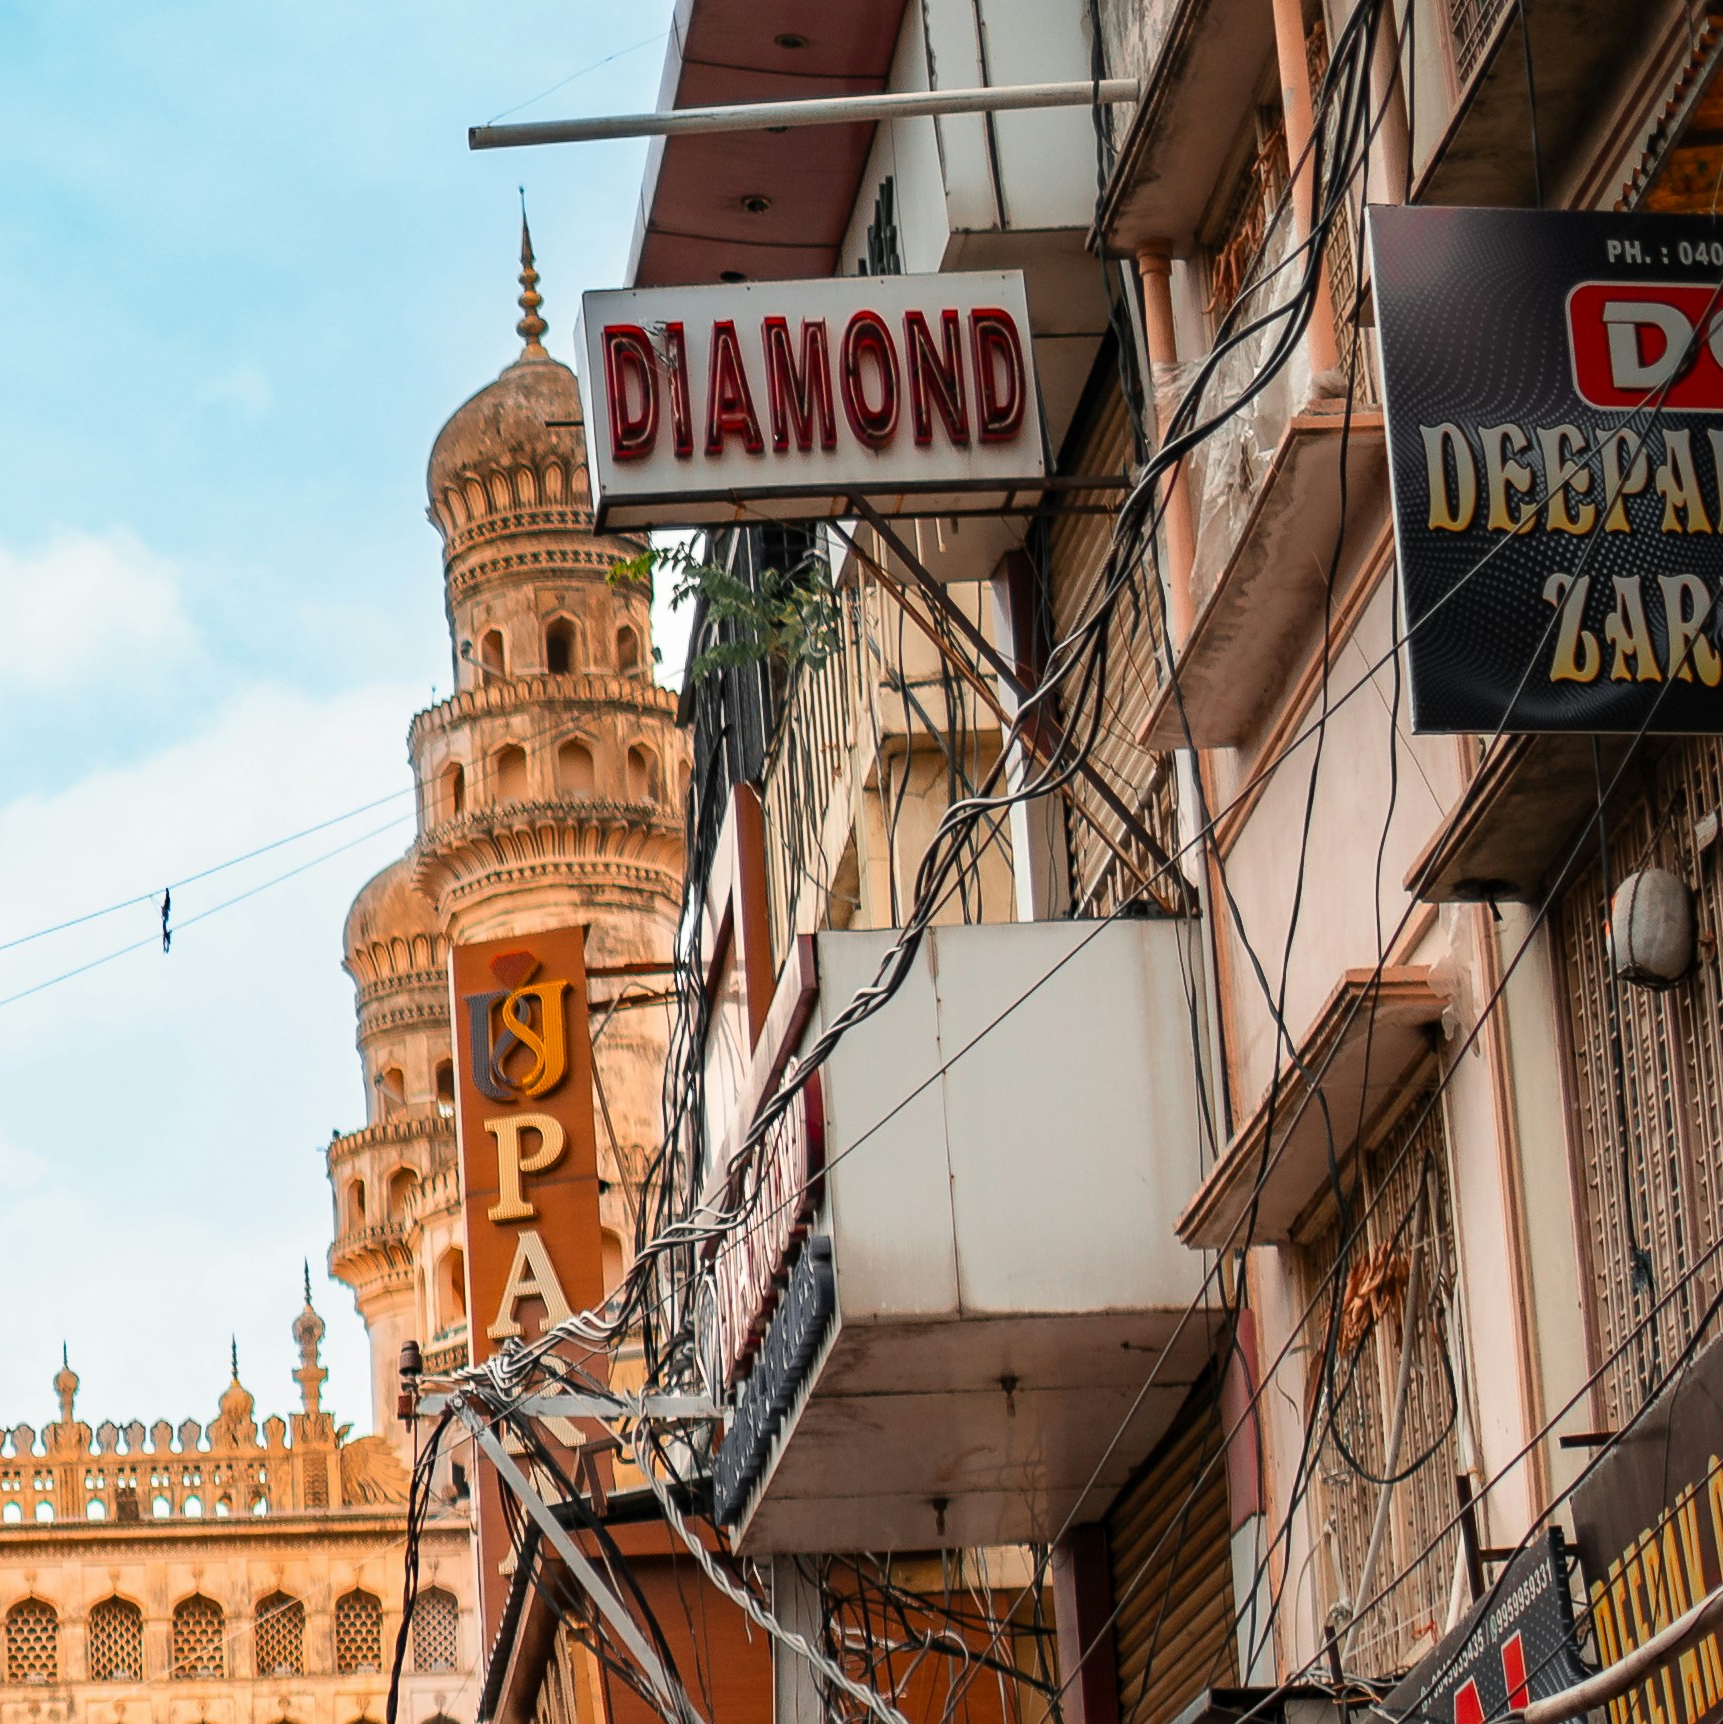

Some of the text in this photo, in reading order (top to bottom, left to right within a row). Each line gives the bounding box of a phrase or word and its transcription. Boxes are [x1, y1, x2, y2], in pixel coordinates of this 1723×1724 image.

[1606, 239, 1651, 264] PH.
[601, 308, 1027, 461] DIAMOND
[1602, 301, 1723, 390] D
[1419, 422, 1723, 535] DEEPA
